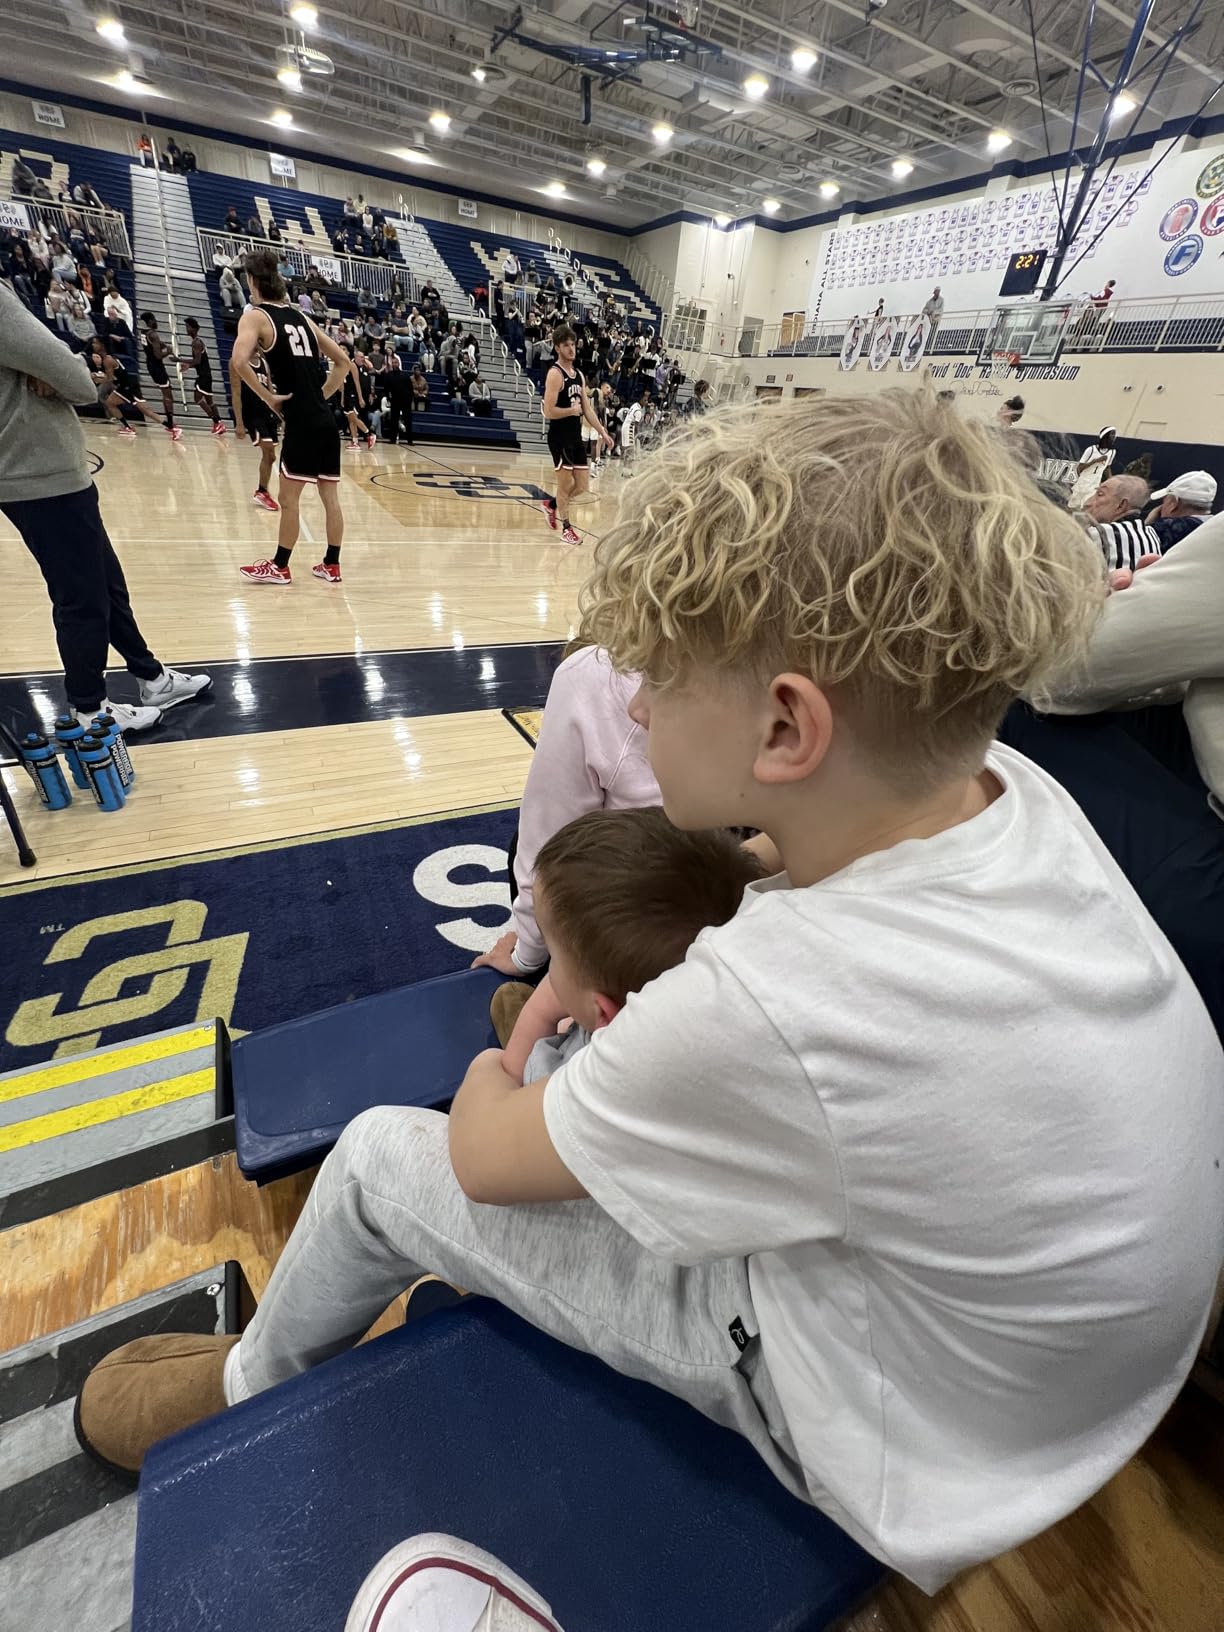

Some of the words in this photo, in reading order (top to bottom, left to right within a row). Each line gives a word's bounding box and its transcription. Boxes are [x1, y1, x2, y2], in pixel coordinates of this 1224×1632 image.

[1015, 254, 1040, 269] 2:21
[284, 323, 313, 357] 21
[110, 744, 129, 786] POWERADE
[115, 733, 133, 775] POWERADE
